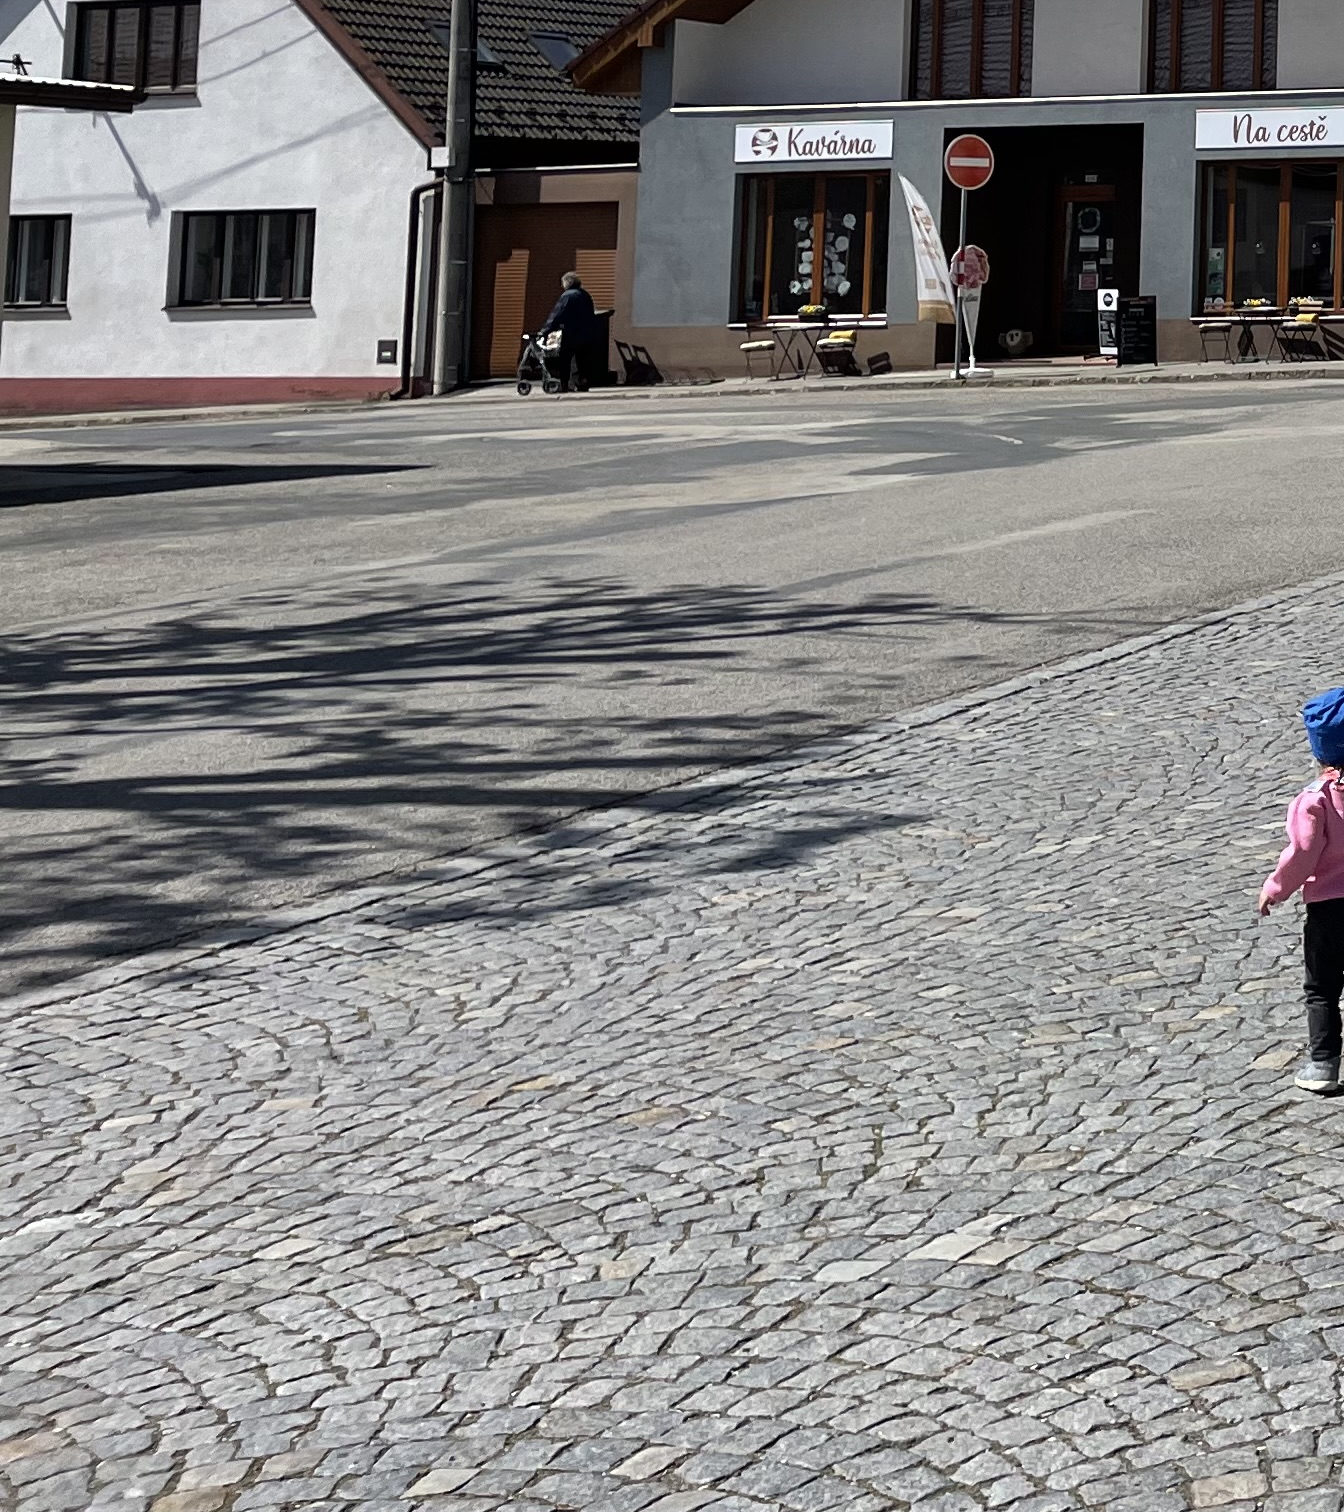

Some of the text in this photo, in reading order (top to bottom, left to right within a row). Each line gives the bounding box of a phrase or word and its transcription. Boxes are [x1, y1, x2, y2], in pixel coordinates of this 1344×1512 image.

[787, 127, 876, 157] Kavárna
[1233, 113, 1329, 144] Na cestě
